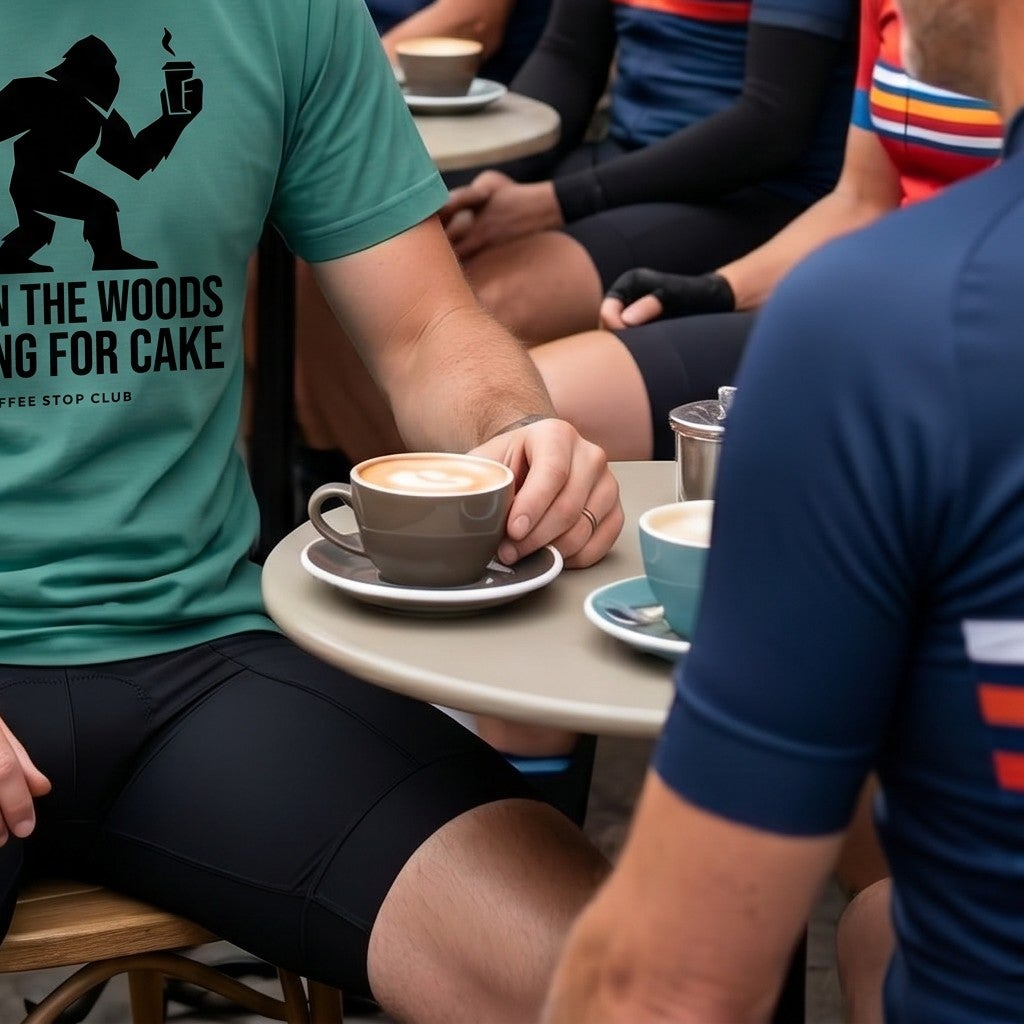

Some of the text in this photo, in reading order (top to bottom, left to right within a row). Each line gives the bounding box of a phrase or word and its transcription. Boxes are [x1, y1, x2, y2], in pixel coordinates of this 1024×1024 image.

[19, 281, 88, 326] THE
[97, 274, 225, 323] WOODS
[49, 330, 119, 377] FOR
[129, 324, 225, 374] CAKE
[42, 393, 84, 407] STOP
[90, 391, 133, 404] CLUB
